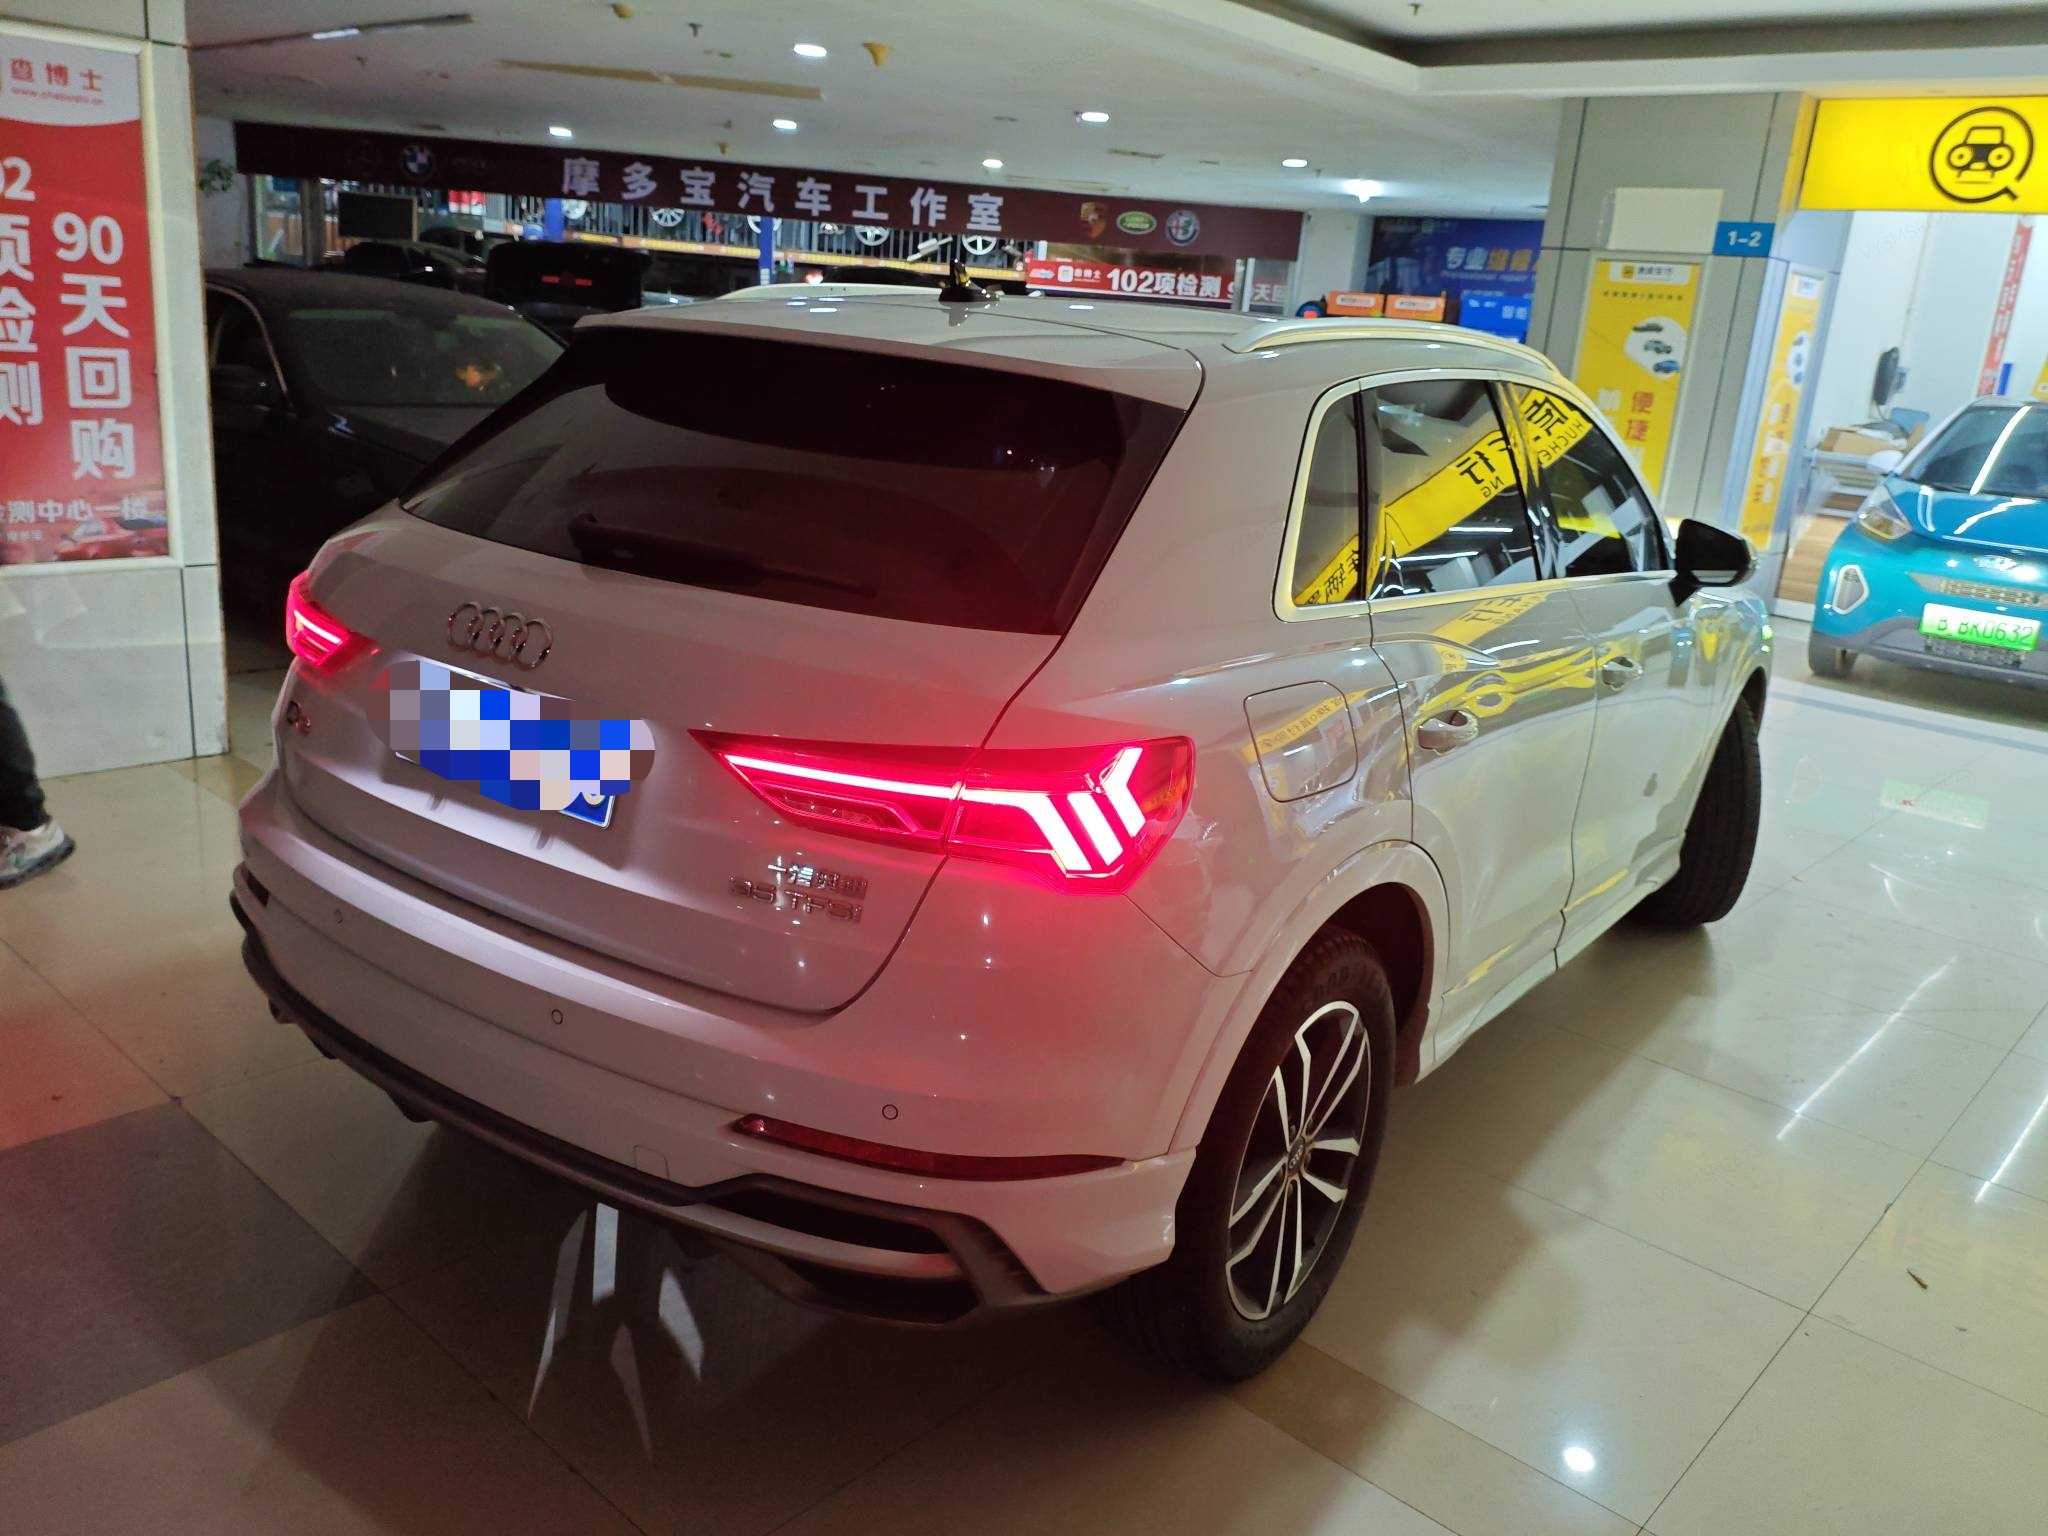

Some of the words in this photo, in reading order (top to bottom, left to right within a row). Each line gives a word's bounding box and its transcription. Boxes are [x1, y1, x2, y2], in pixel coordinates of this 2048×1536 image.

[562, 157, 1004, 232] 摩多宝汽车工作室
[1727, 230, 1763, 248] 1-2
[1106, 267, 1222, 299] 102项检测
